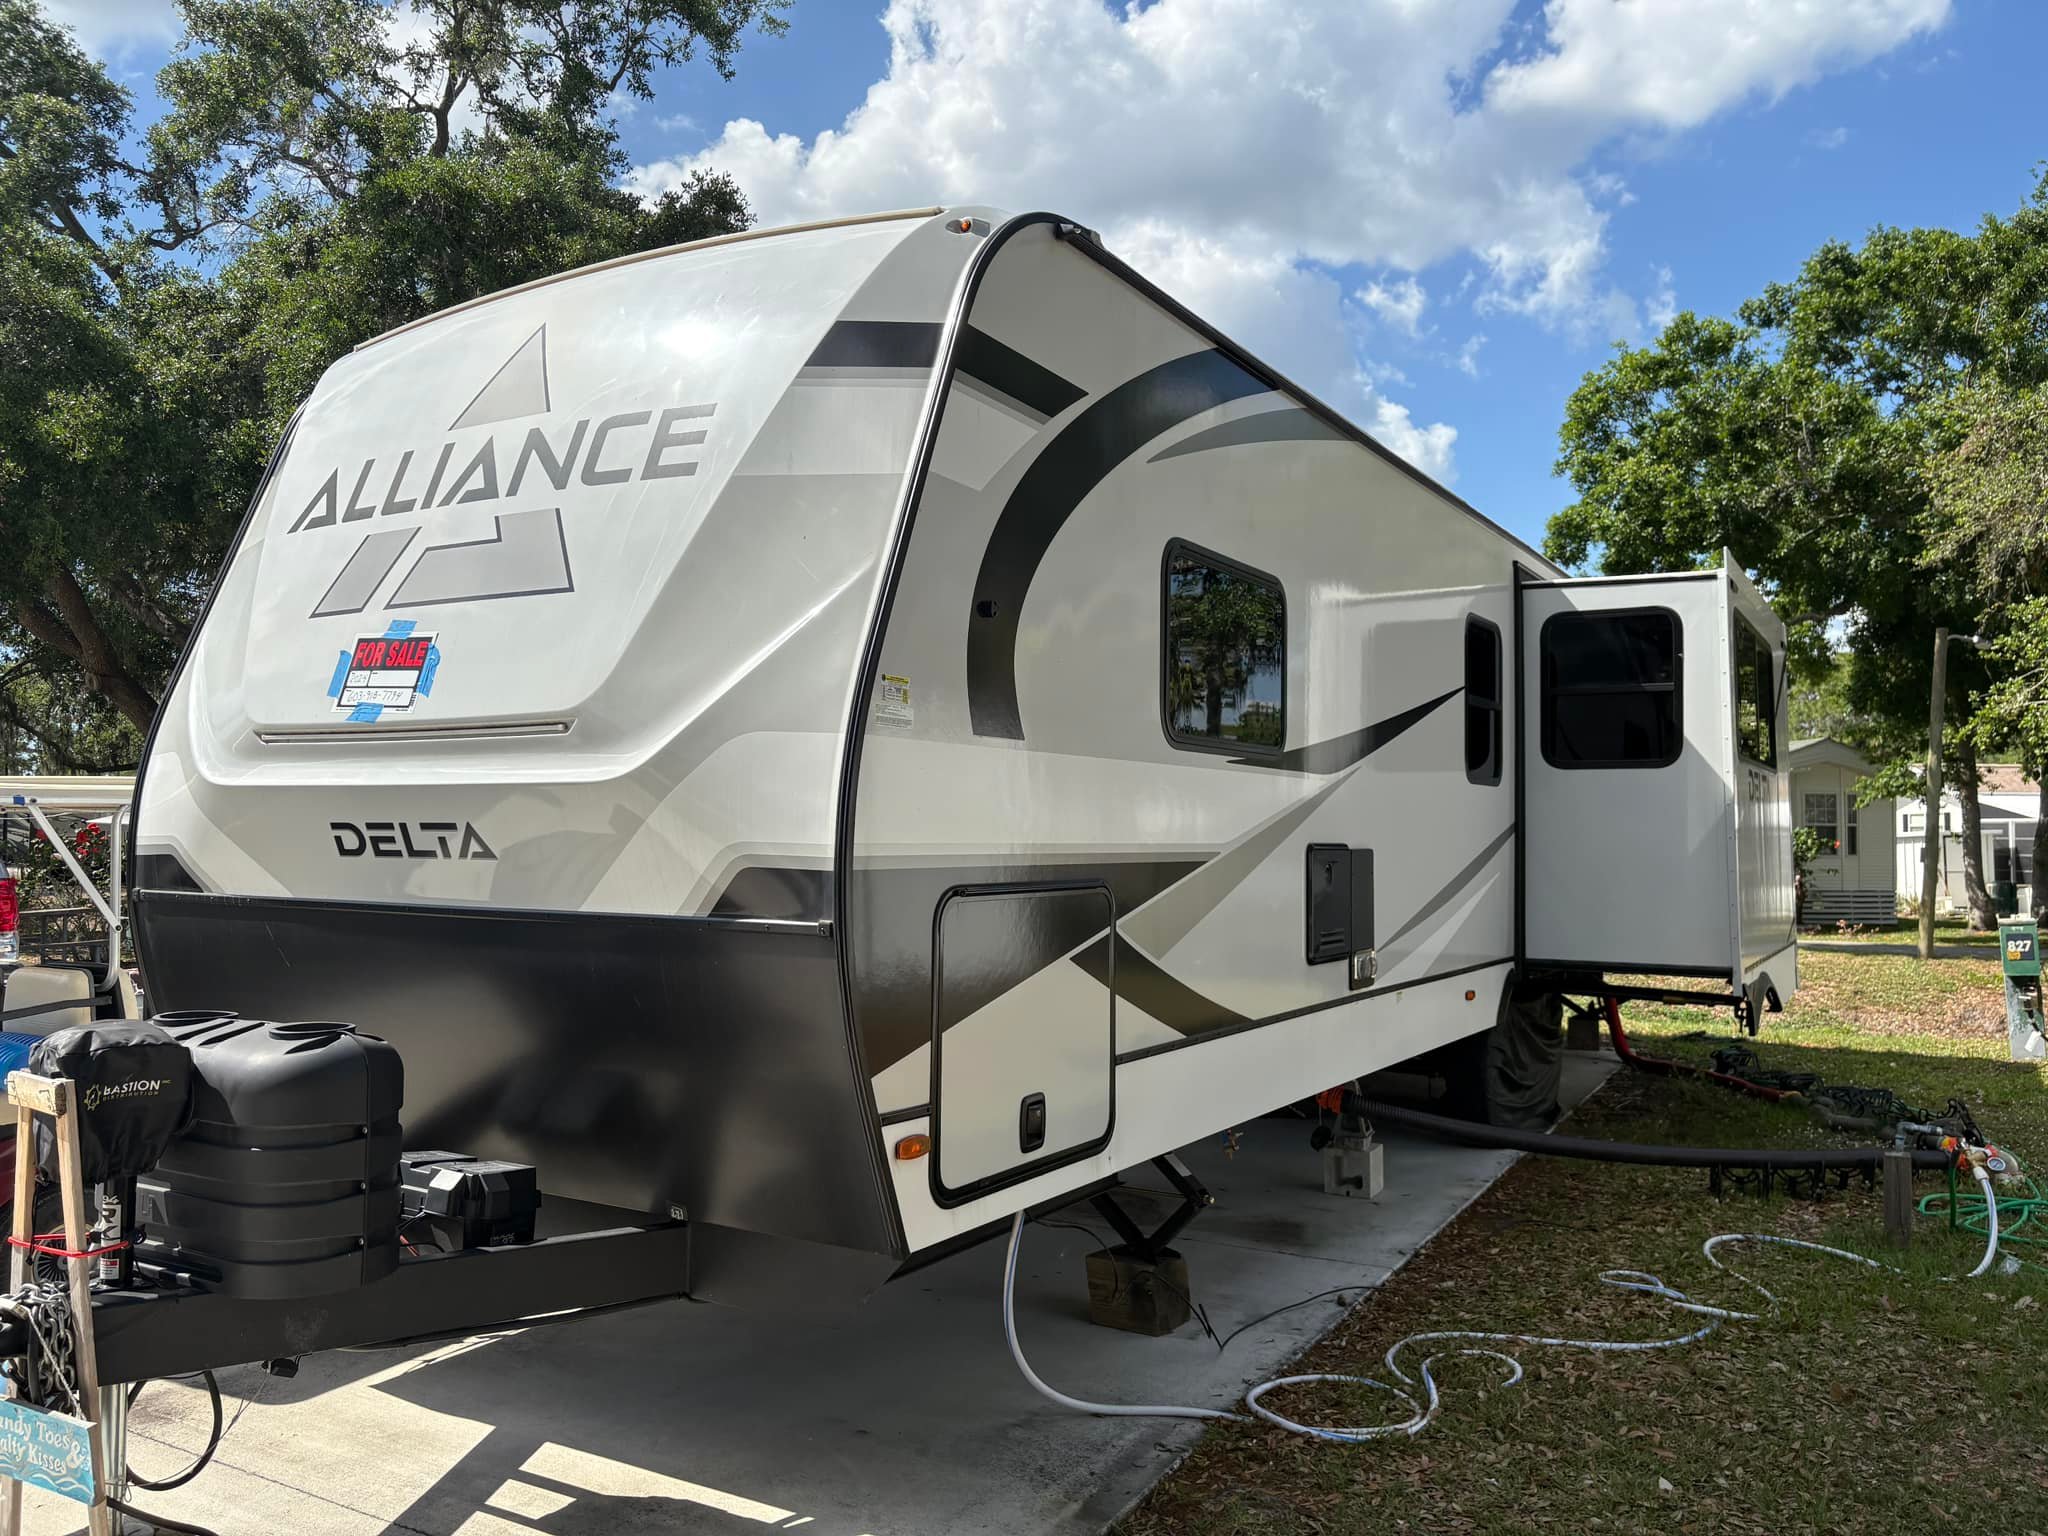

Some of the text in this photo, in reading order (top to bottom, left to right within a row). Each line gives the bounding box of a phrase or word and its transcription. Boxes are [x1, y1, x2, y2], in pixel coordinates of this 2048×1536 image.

[287, 402, 718, 535] ALLIANCE
[352, 639, 429, 668] FOR SALE
[329, 821, 499, 861] DELTA
[2007, 940, 2032, 953] 827
[103, 1080, 160, 1096] BASTION
[36, 1421, 72, 1449] Toes
[28, 1442, 67, 1473] Kisses
